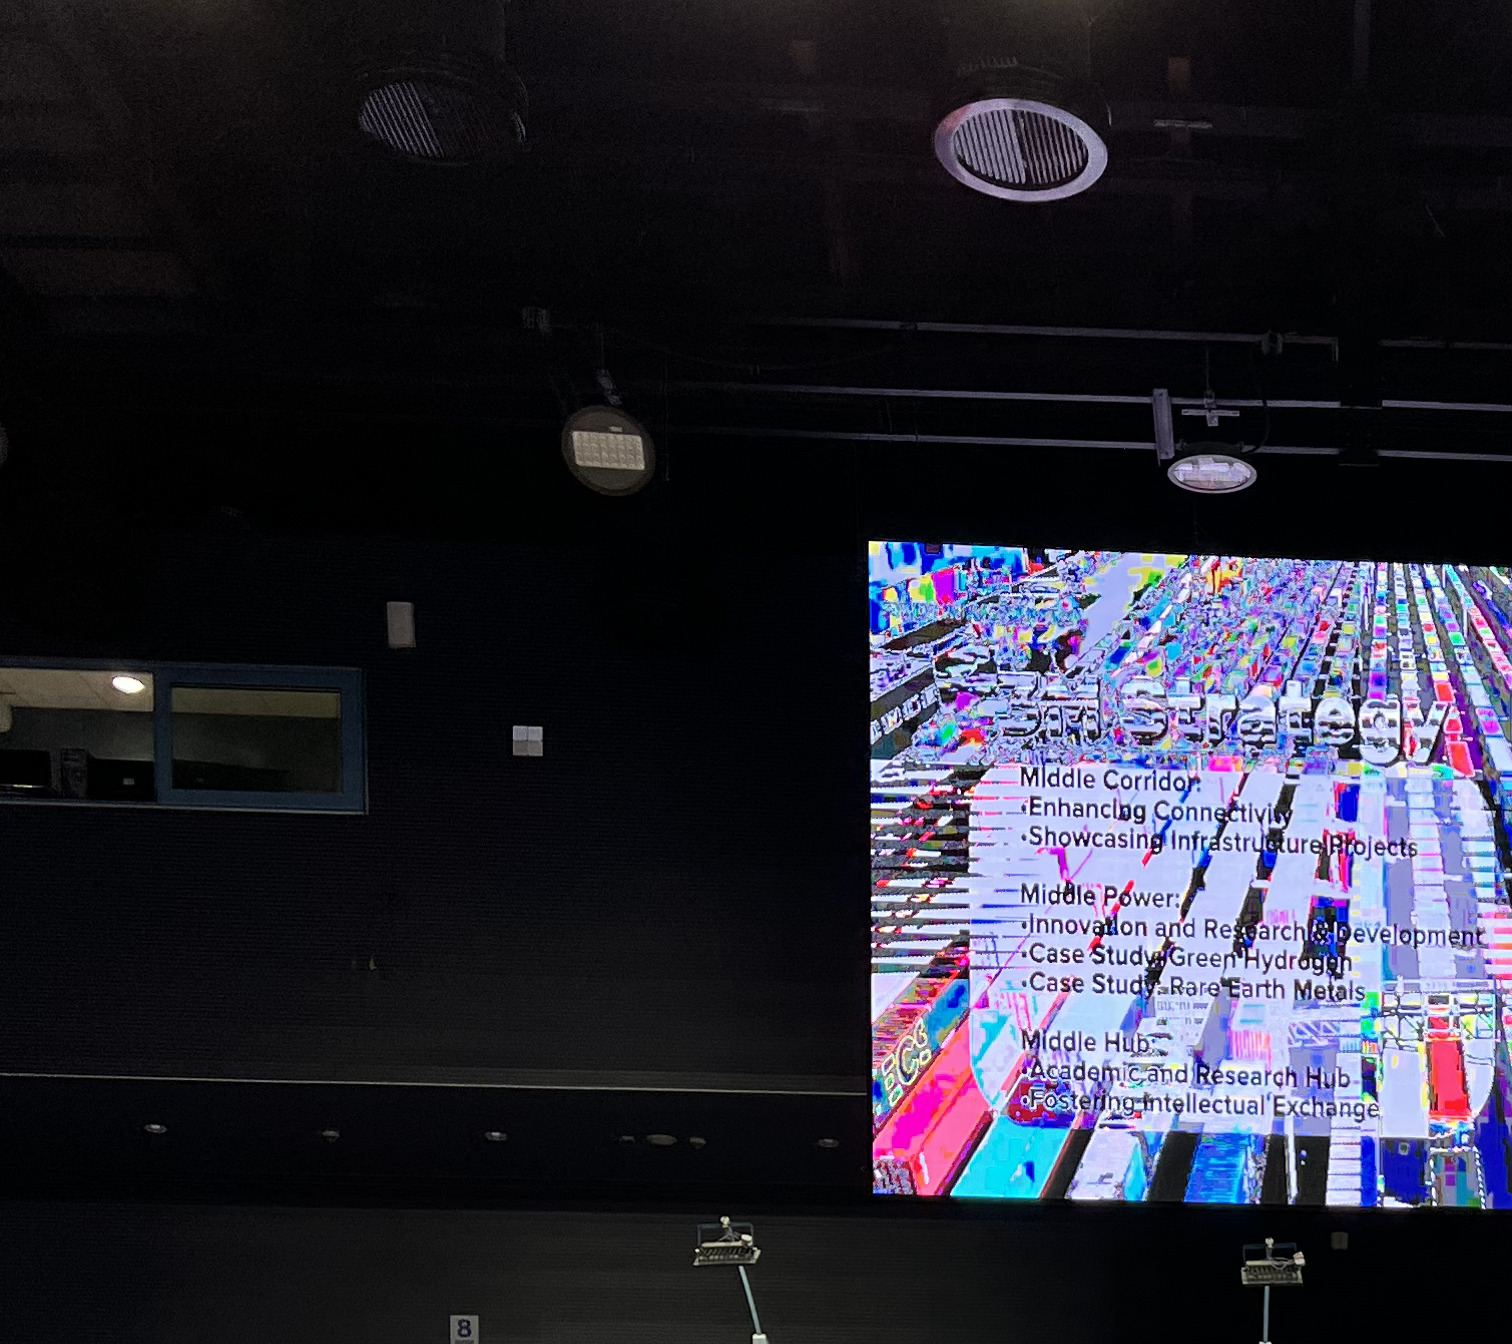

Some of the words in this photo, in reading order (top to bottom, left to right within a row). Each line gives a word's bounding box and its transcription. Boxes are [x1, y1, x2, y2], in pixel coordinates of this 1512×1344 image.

[1020, 767, 1096, 789] Middle
[1103, 769, 1202, 792] Corridor:
[1029, 796, 1146, 825] Enhancing
[1154, 800, 1293, 830] Connectivity
[1029, 826, 1163, 855] Showcasing
[1171, 829, 1323, 854] Infrastructure
[1330, 834, 1418, 860] Projects
[1021, 883, 1096, 905] Middle
[1104, 886, 1181, 908] Power:
[1029, 913, 1147, 936] Innovation
[1155, 918, 1196, 938] and
[1204, 919, 1307, 942] Research
[1337, 922, 1486, 948] Development
[1029, 943, 1085, 964] Case
[1170, 947, 1237, 968] Green
[1245, 949, 1353, 978] Hydrogen
[1029, 971, 1085, 993] Case
[1171, 976, 1221, 996] Rare
[1229, 977, 1286, 999] Earth
[1294, 979, 1366, 1001] Metals
[1022, 1030, 1097, 1052] Middle
[1030, 1058, 1145, 1082] Academic
[1147, 1063, 1188, 1083] and
[1197, 1063, 1298, 1087] Research
[1306, 1066, 1351, 1088] Hub
[1030, 1088, 1136, 1116] Fostering
[1144, 1092, 1265, 1116] Intellectual
[1273, 1095, 1381, 1123] Exchange
[458, 1319, 472, 1338] 8
